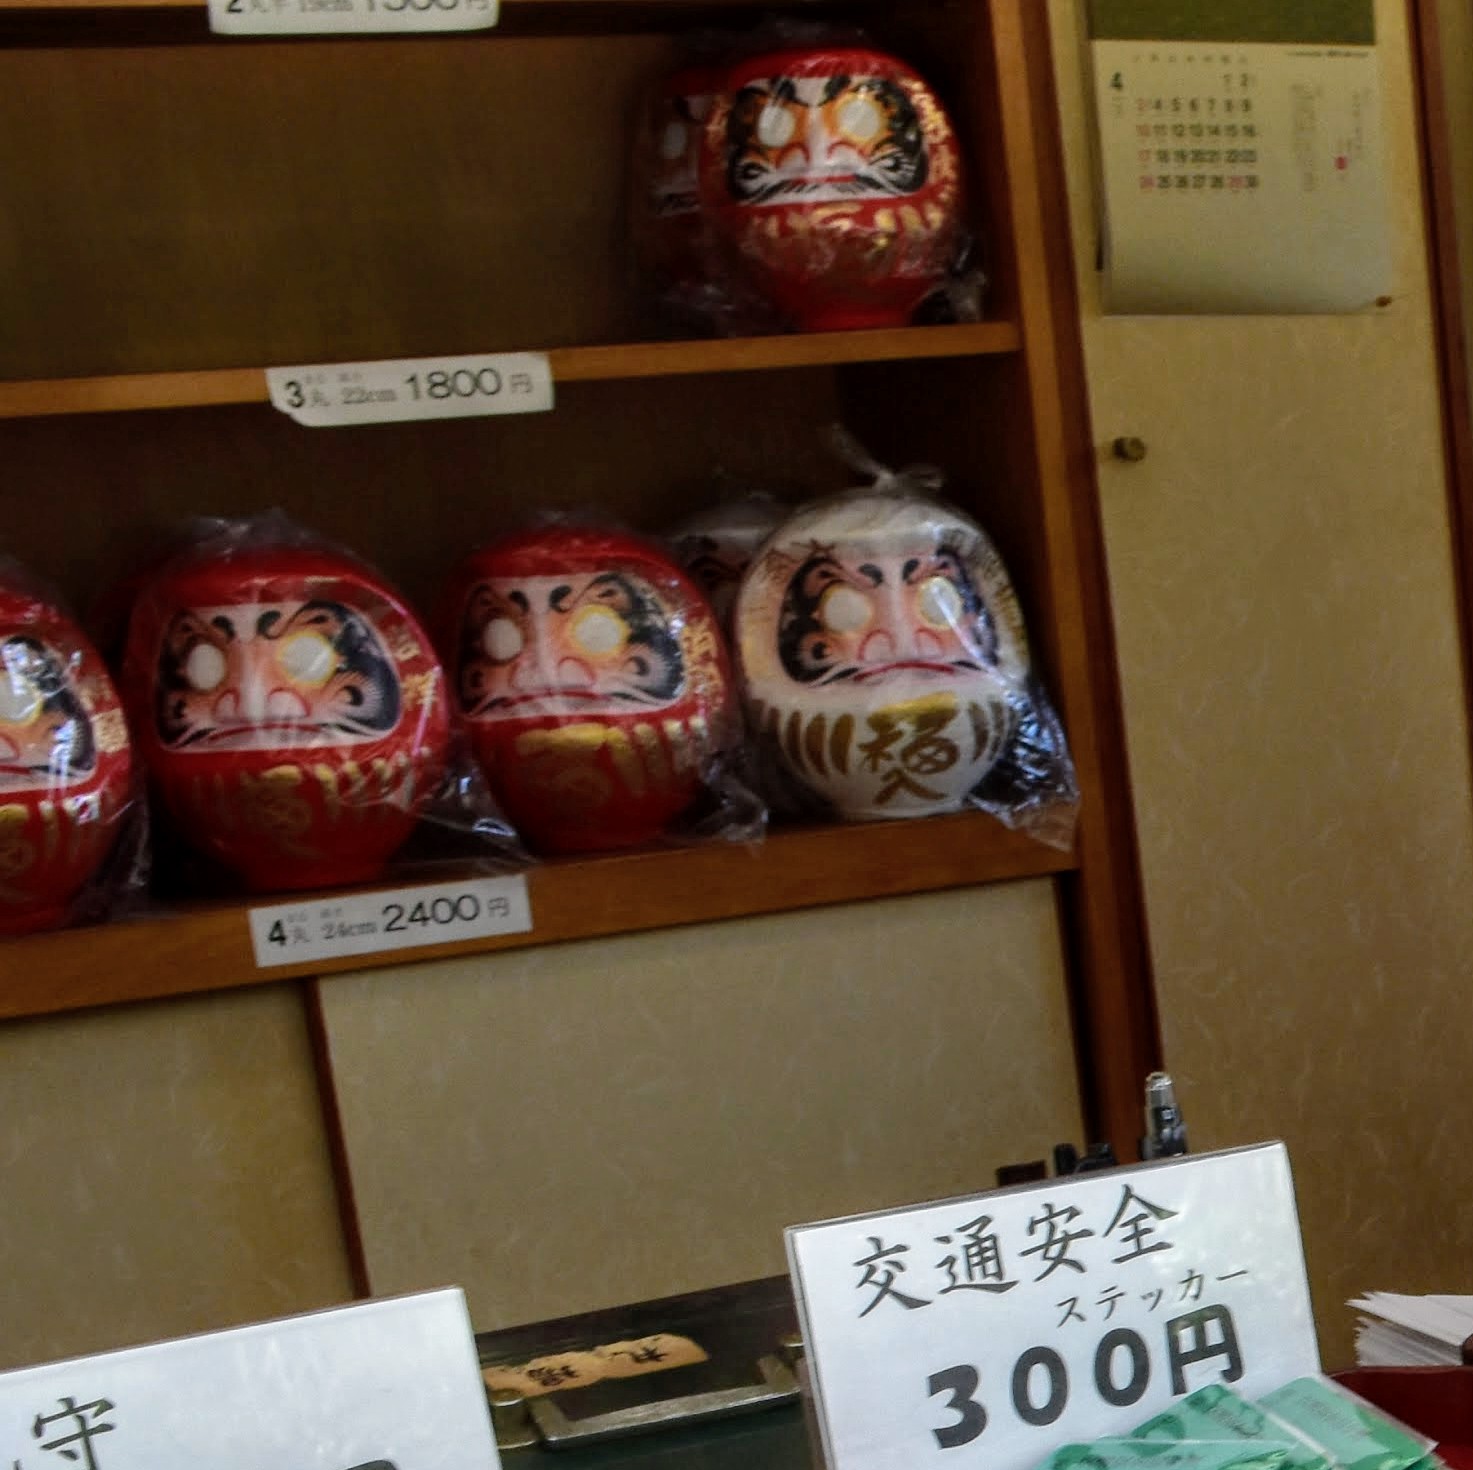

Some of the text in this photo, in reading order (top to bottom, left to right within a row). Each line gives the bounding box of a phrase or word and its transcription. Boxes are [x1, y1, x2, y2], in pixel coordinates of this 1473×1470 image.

[851, 1183, 1181, 1318] 交通安全
[1055, 1268, 1250, 1329] ステッカー
[927, 1302, 1245, 1451] 300円
